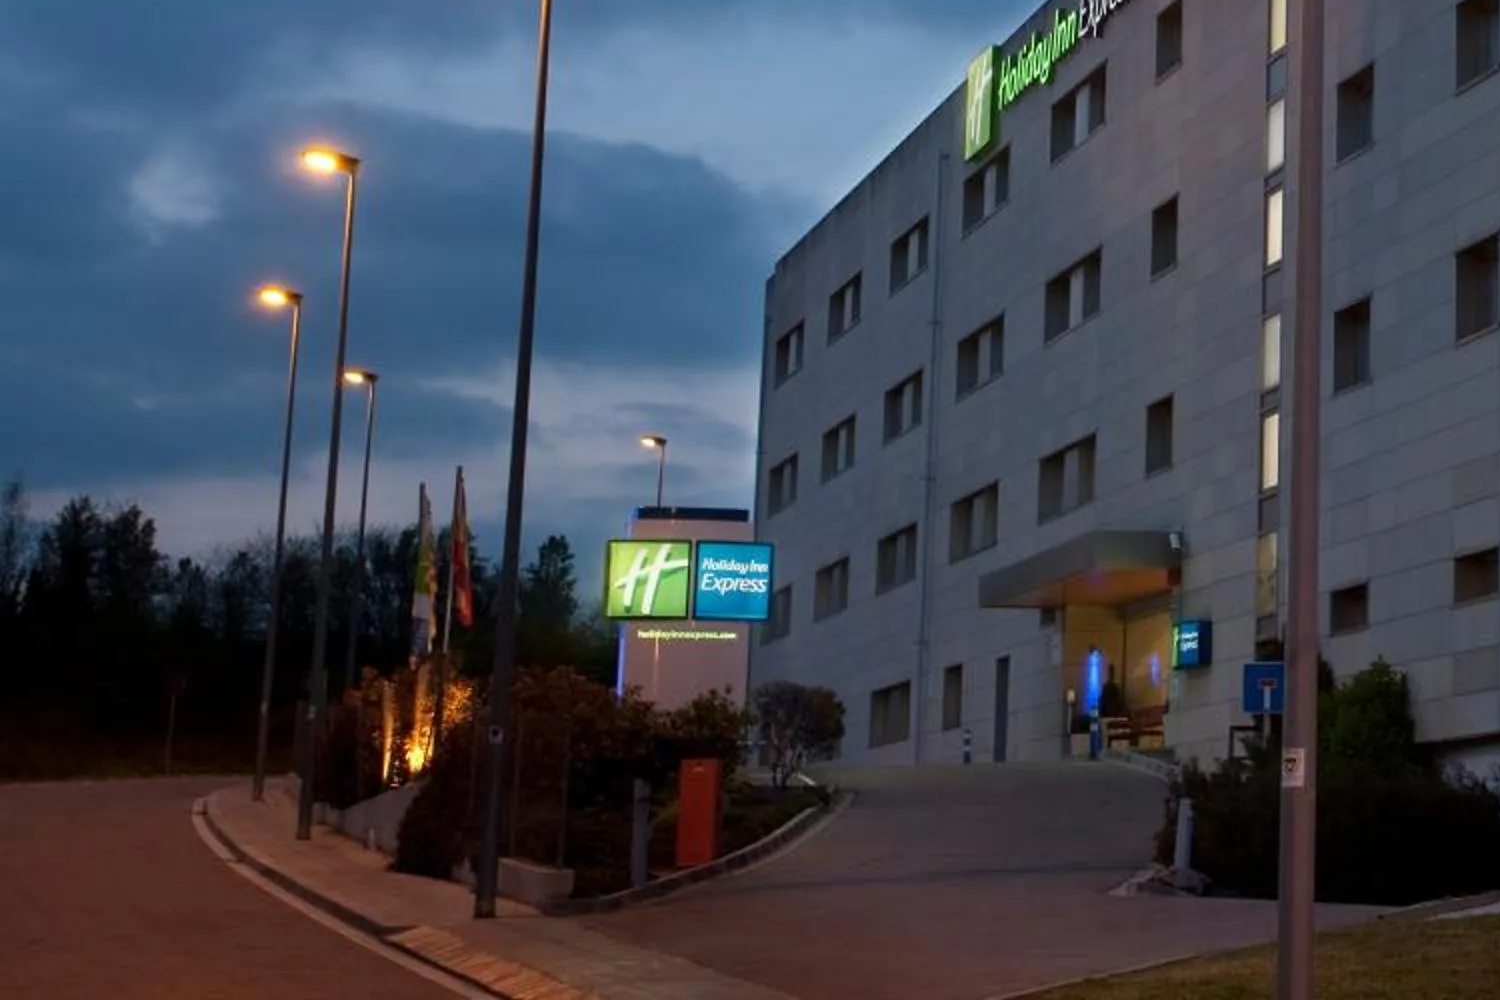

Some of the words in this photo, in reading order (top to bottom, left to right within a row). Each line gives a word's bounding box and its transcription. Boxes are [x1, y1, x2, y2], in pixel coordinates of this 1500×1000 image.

[998, 31, 1053, 111] Holiday
[1052, 8, 1077, 62] Inn
[702, 557, 749, 574] Holiday
[749, 560, 769, 573] Inn
[701, 573, 769, 596] Express
